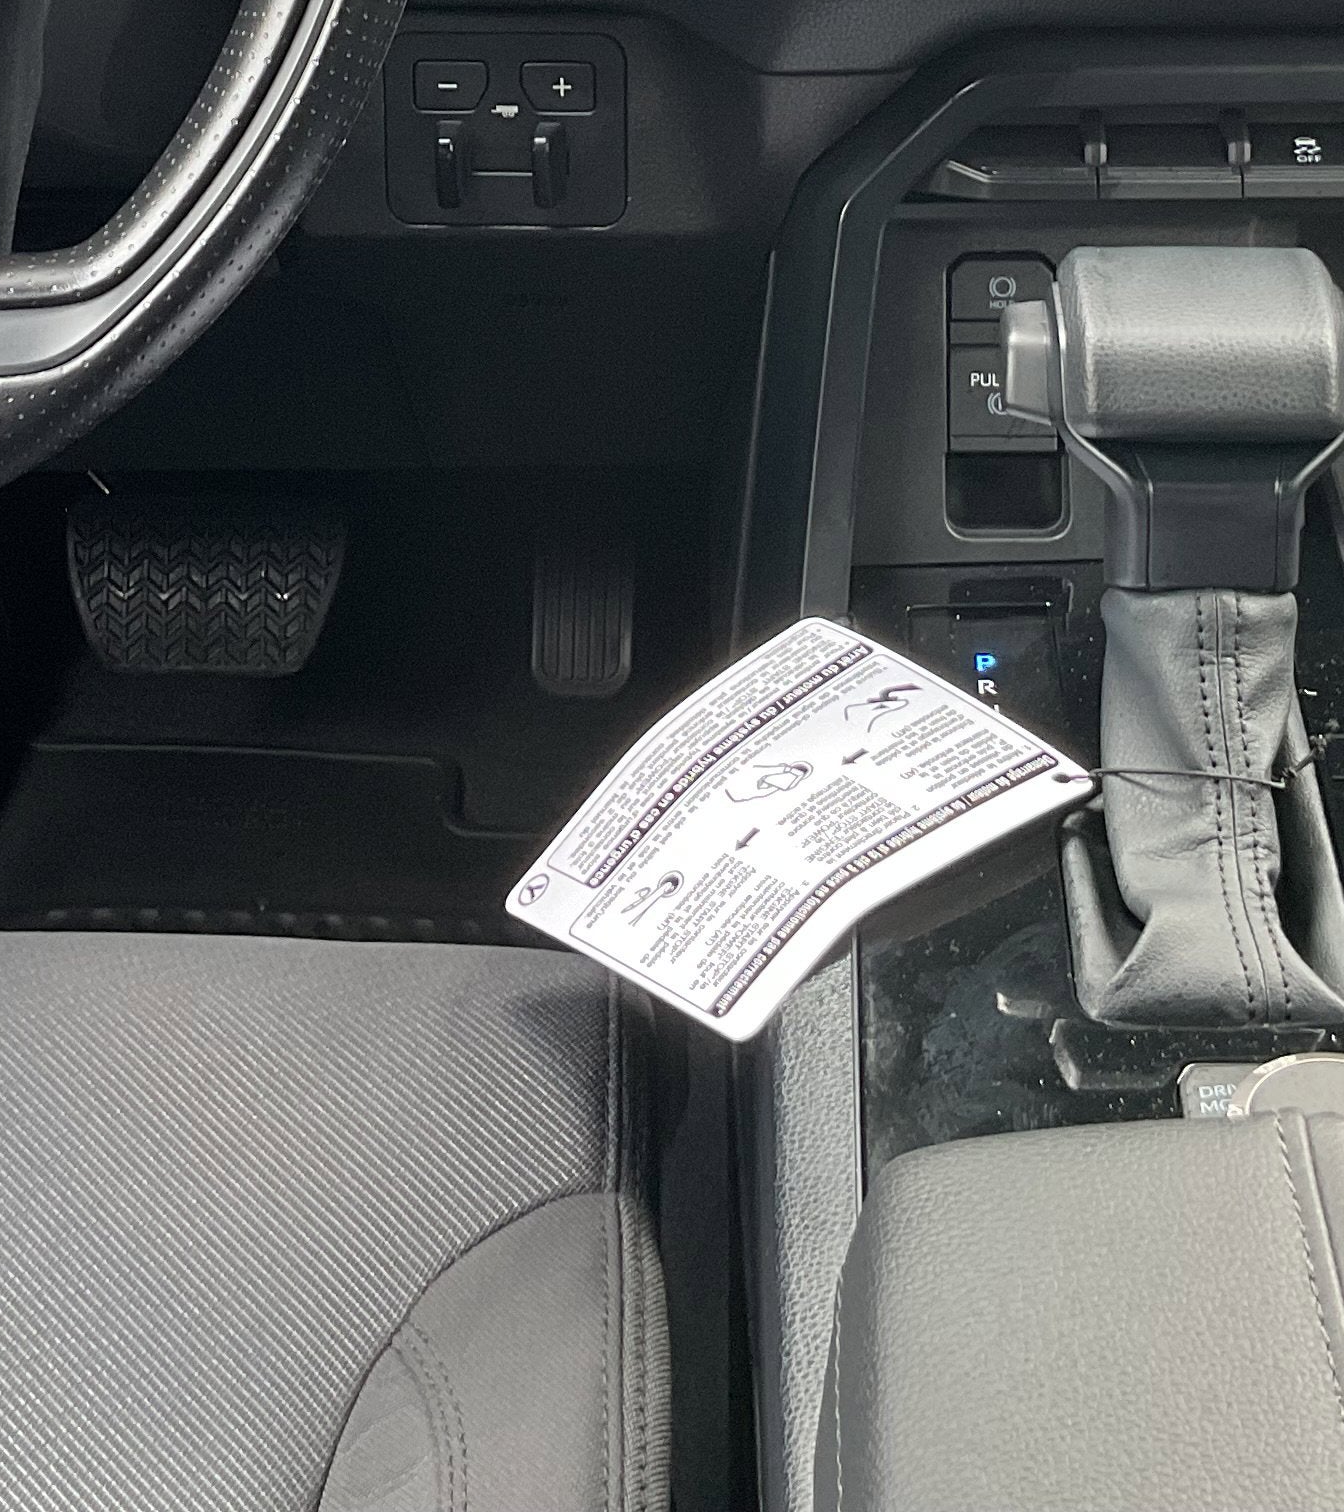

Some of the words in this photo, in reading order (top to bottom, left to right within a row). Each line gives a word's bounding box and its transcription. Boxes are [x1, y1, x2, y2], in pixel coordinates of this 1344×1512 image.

[969, 372, 1000, 387] PUL
[835, 644, 870, 667] Arrêt
[975, 654, 997, 673] P
[819, 663, 843, 677] du
[778, 674, 825, 703] moteur
[977, 679, 998, 695] R
[757, 705, 780, 720] du
[710, 716, 763, 756] système
[668, 752, 716, 793] hybride
[656, 791, 676, 808] en
[637, 807, 661, 829] cas
[585, 827, 643, 887] d'urgence
[1199, 1083, 1237, 1099] DRI
